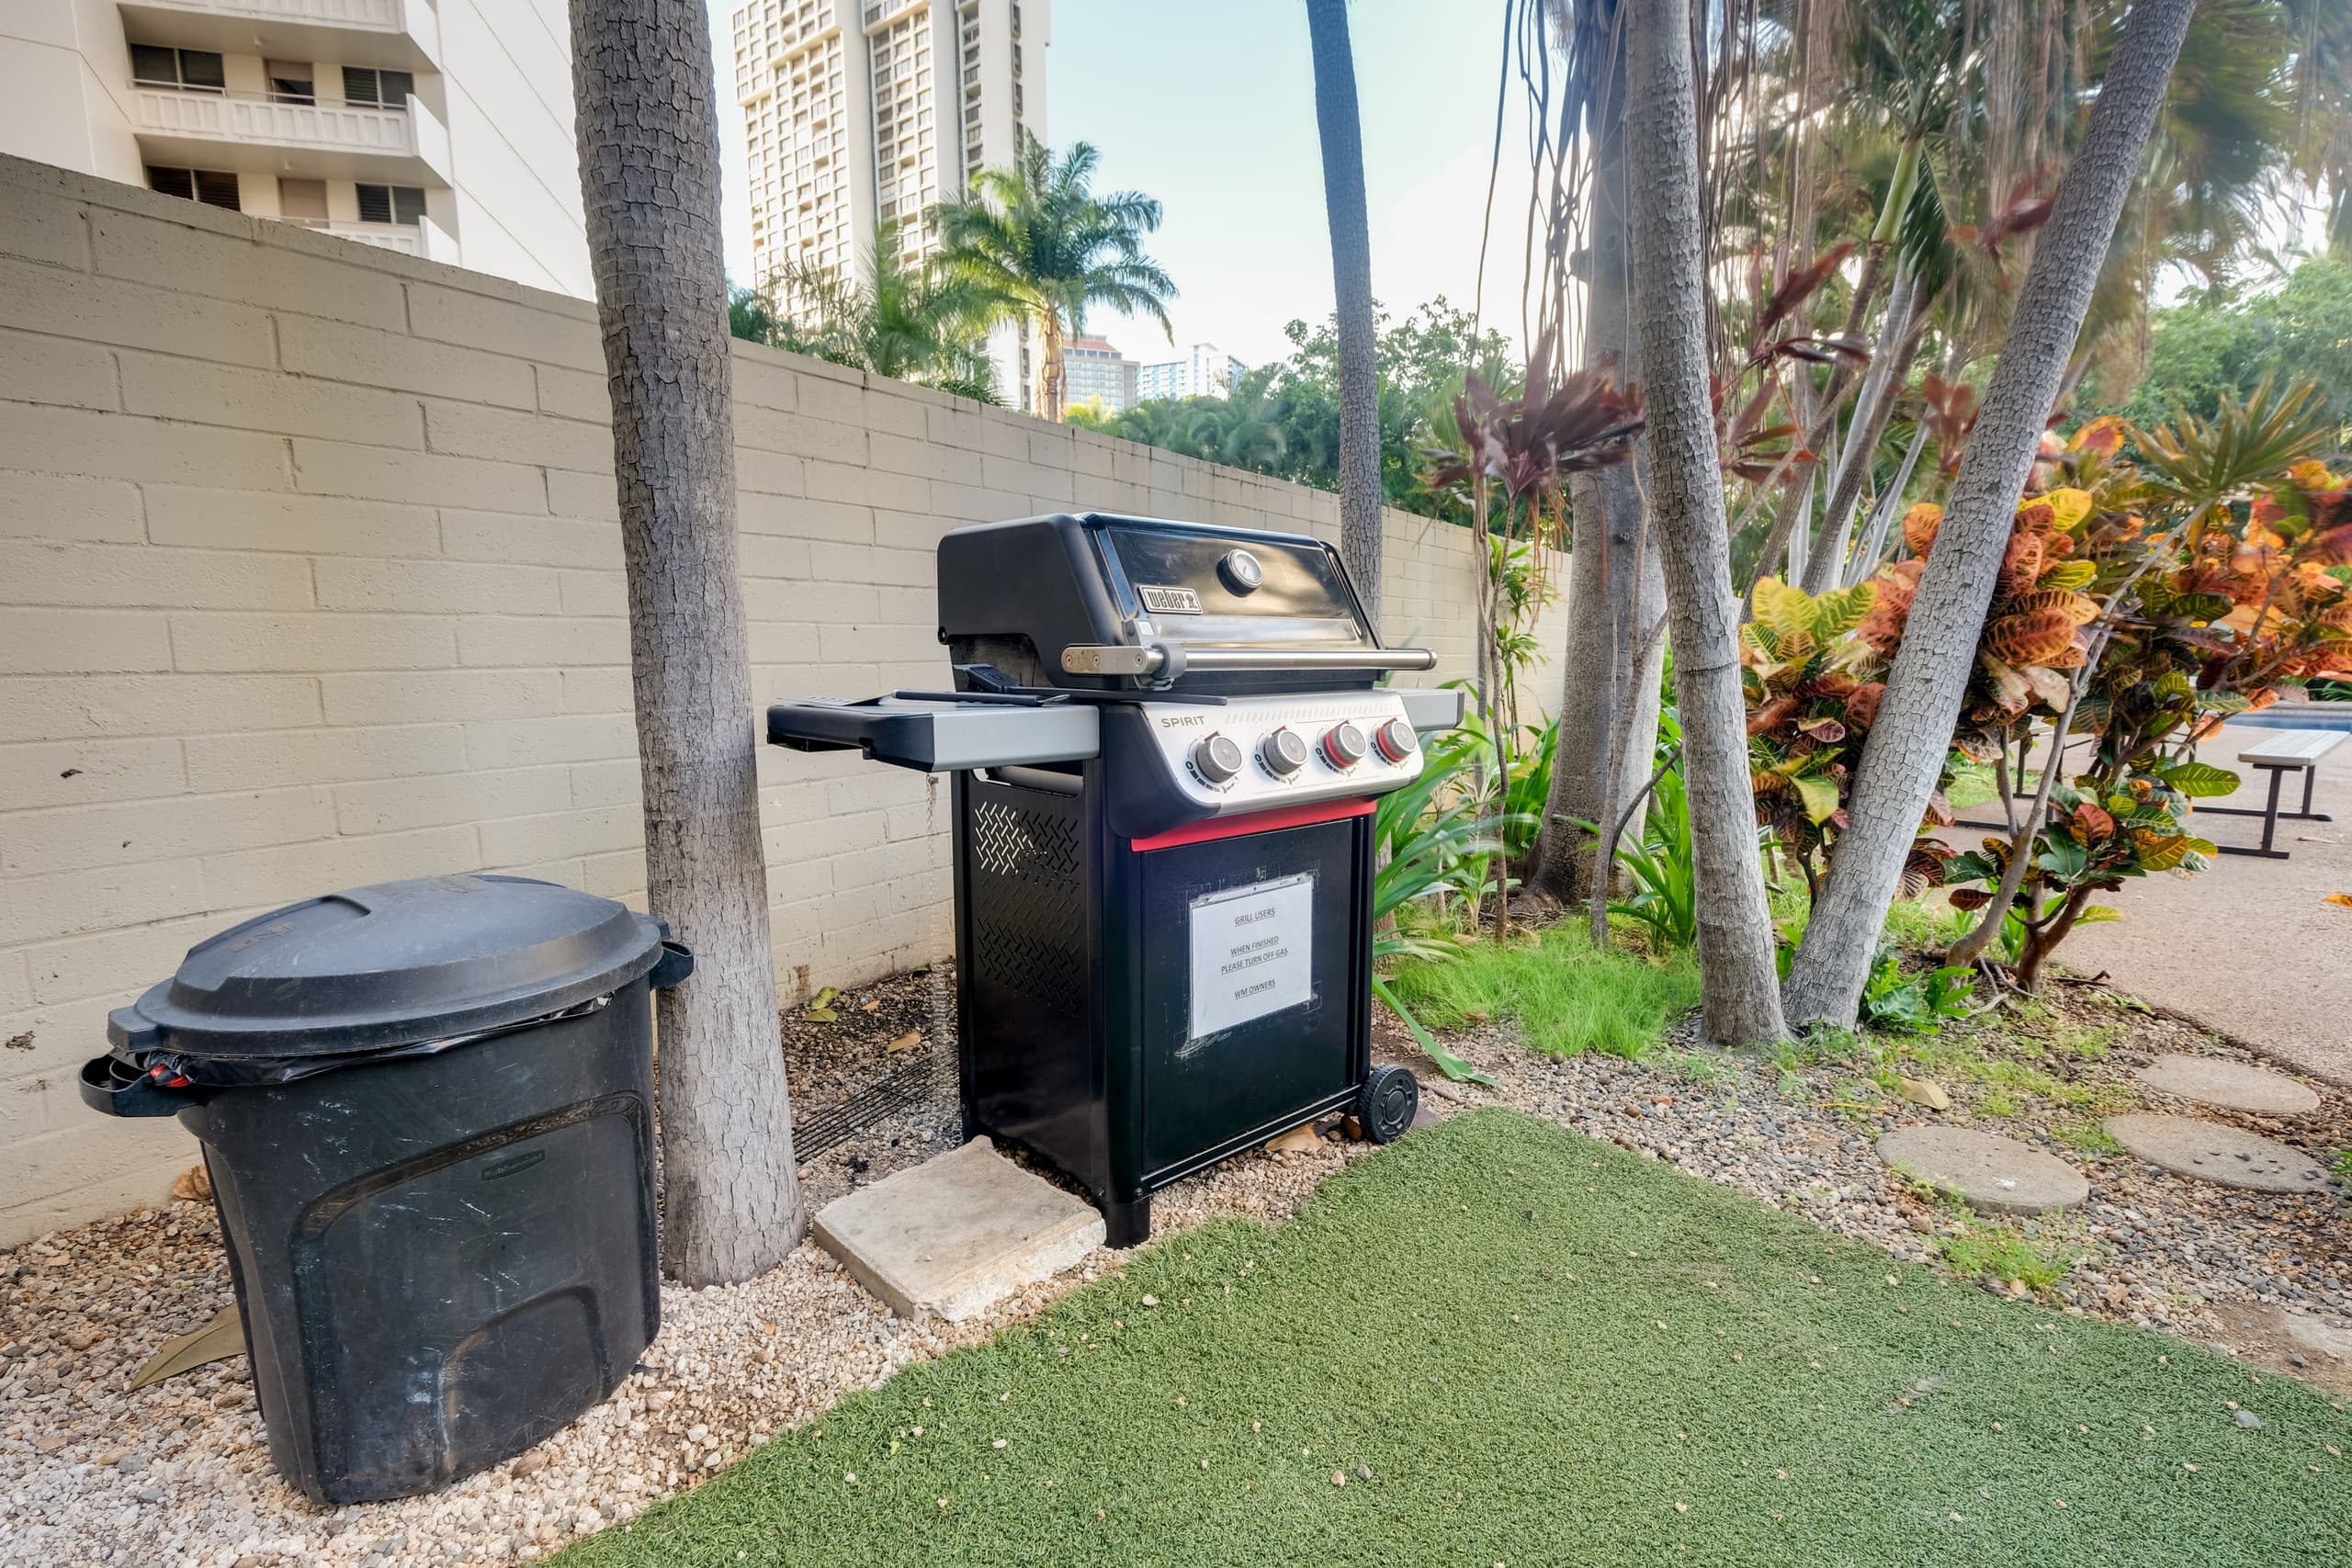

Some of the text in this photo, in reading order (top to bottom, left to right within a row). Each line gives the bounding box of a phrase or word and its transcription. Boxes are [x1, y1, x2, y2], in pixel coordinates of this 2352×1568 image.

[1146, 589, 1185, 609] weber
[1160, 716, 1205, 728] SPIRIT
[1234, 908, 1275, 925] GRILL USERS
[1230, 936, 1279, 956] WHEN FINISHED
[1221, 948, 1288, 974] PLEASE TURN OFF GAS
[1234, 979, 1276, 998] WM OWNERS
